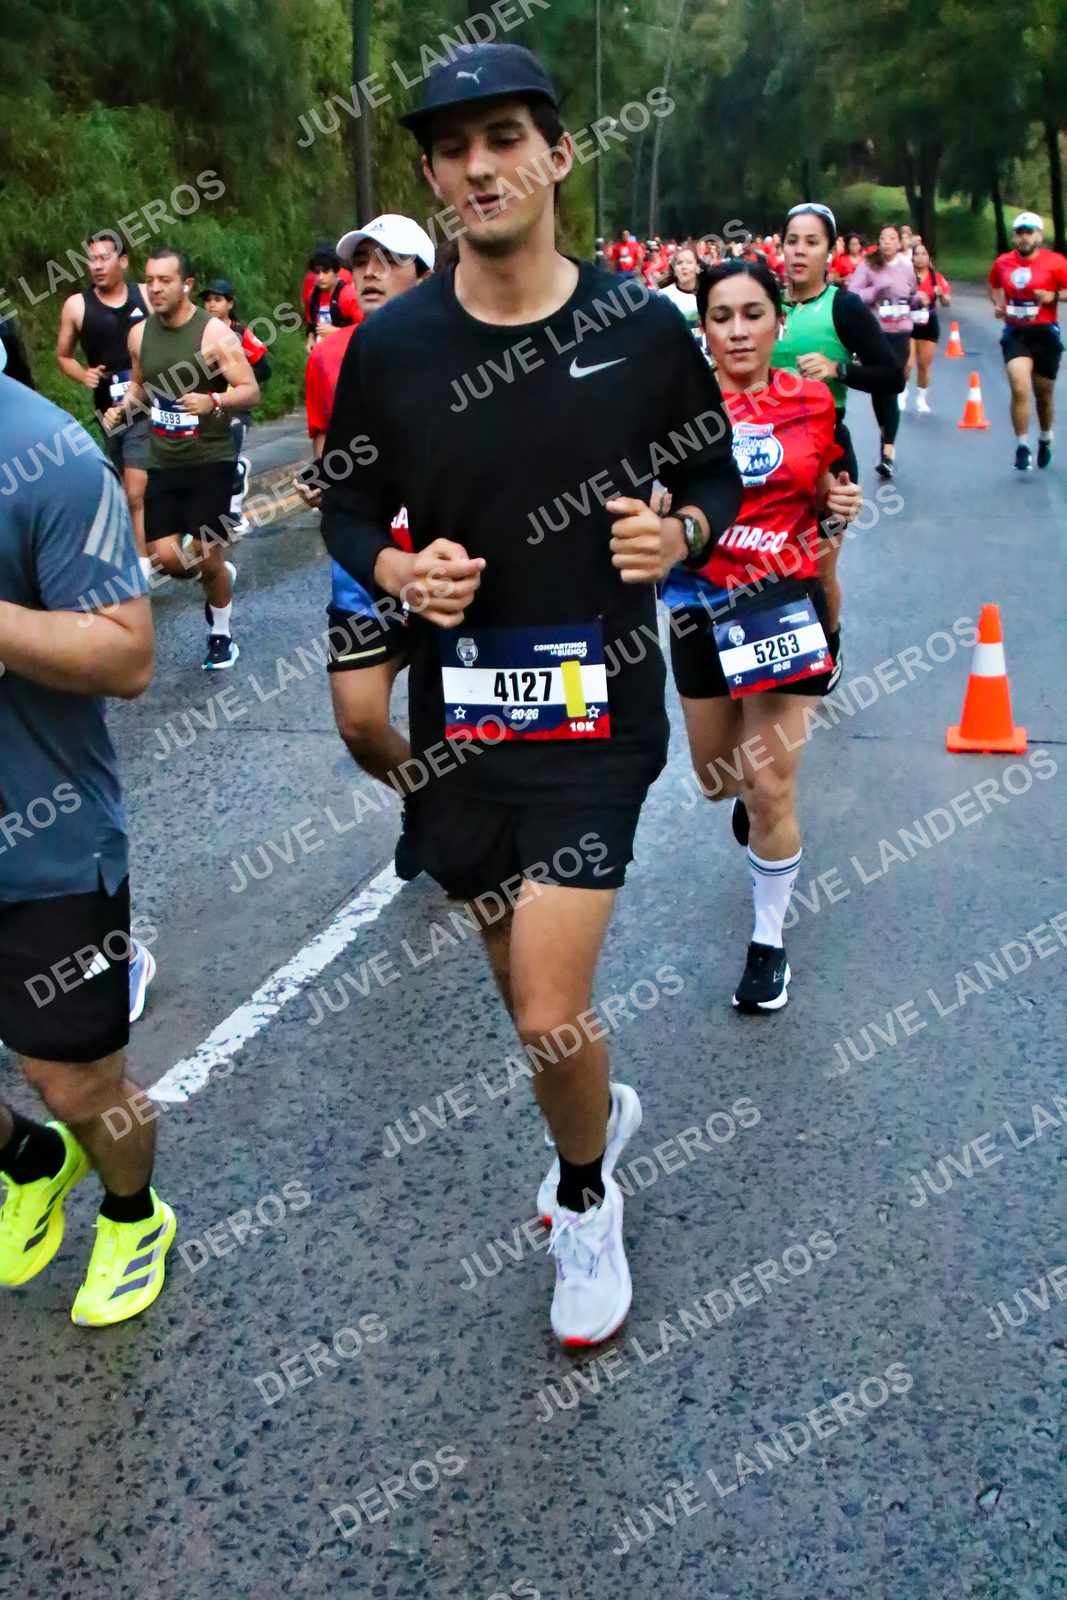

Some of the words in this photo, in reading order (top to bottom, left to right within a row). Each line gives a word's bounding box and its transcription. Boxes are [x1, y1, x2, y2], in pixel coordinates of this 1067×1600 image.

[753, 633, 801, 664] 5263
[494, 671, 552, 702] 4127
[569, 721, 596, 731] 10K
